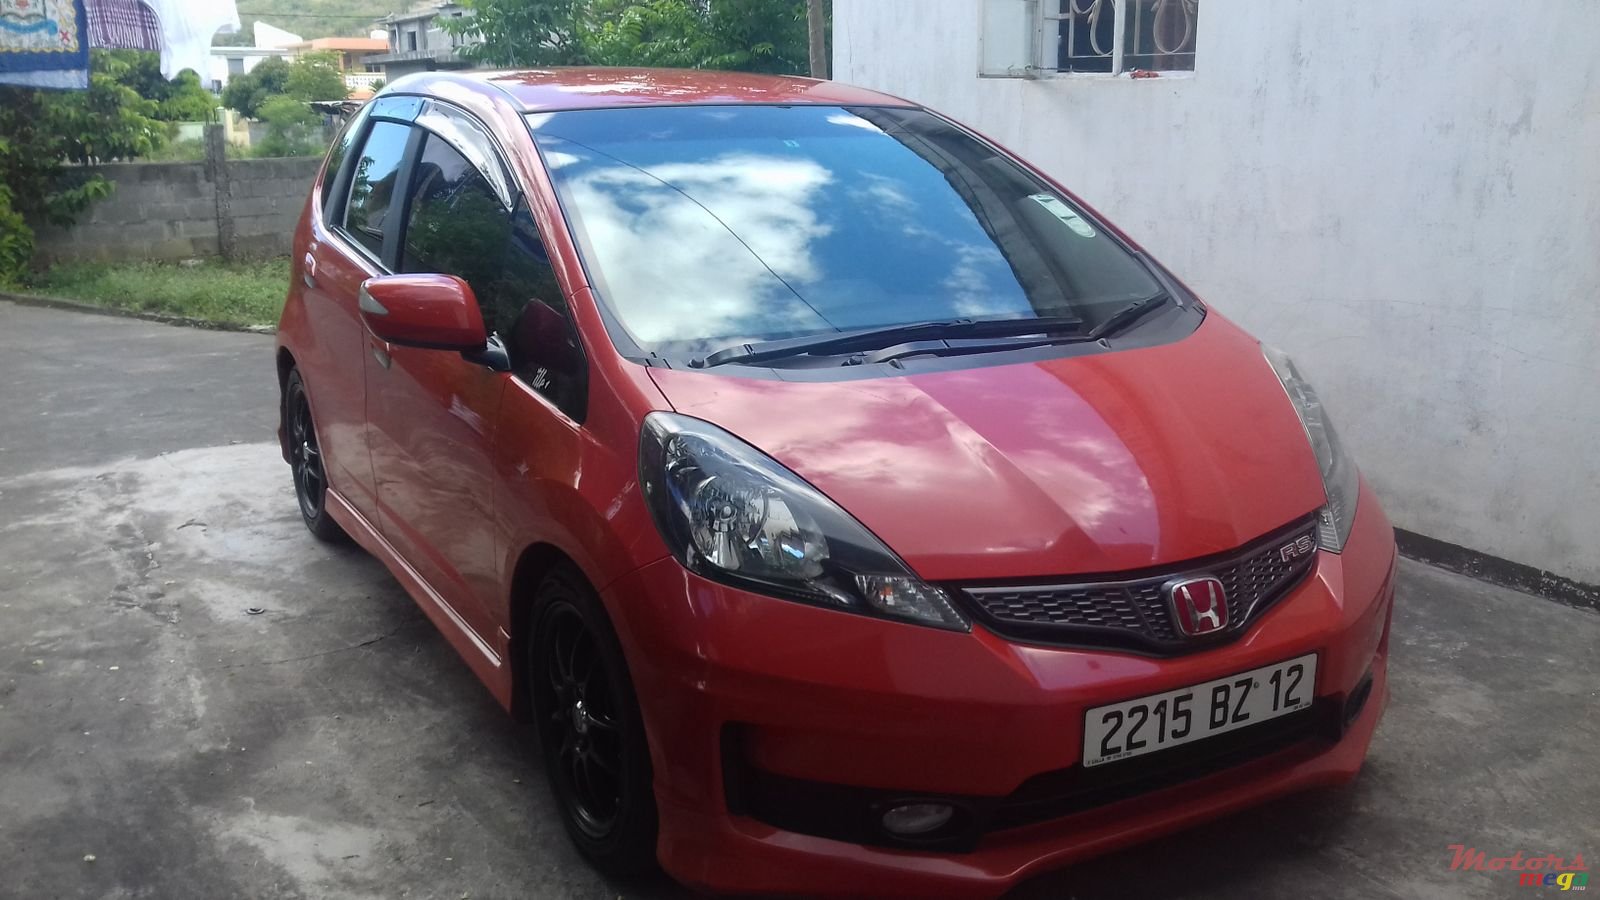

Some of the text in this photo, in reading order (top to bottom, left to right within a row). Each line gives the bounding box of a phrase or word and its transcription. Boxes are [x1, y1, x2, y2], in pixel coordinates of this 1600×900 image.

[1279, 535, 1313, 562] RS
[1100, 664, 1304, 757] 2215 BZ 12
